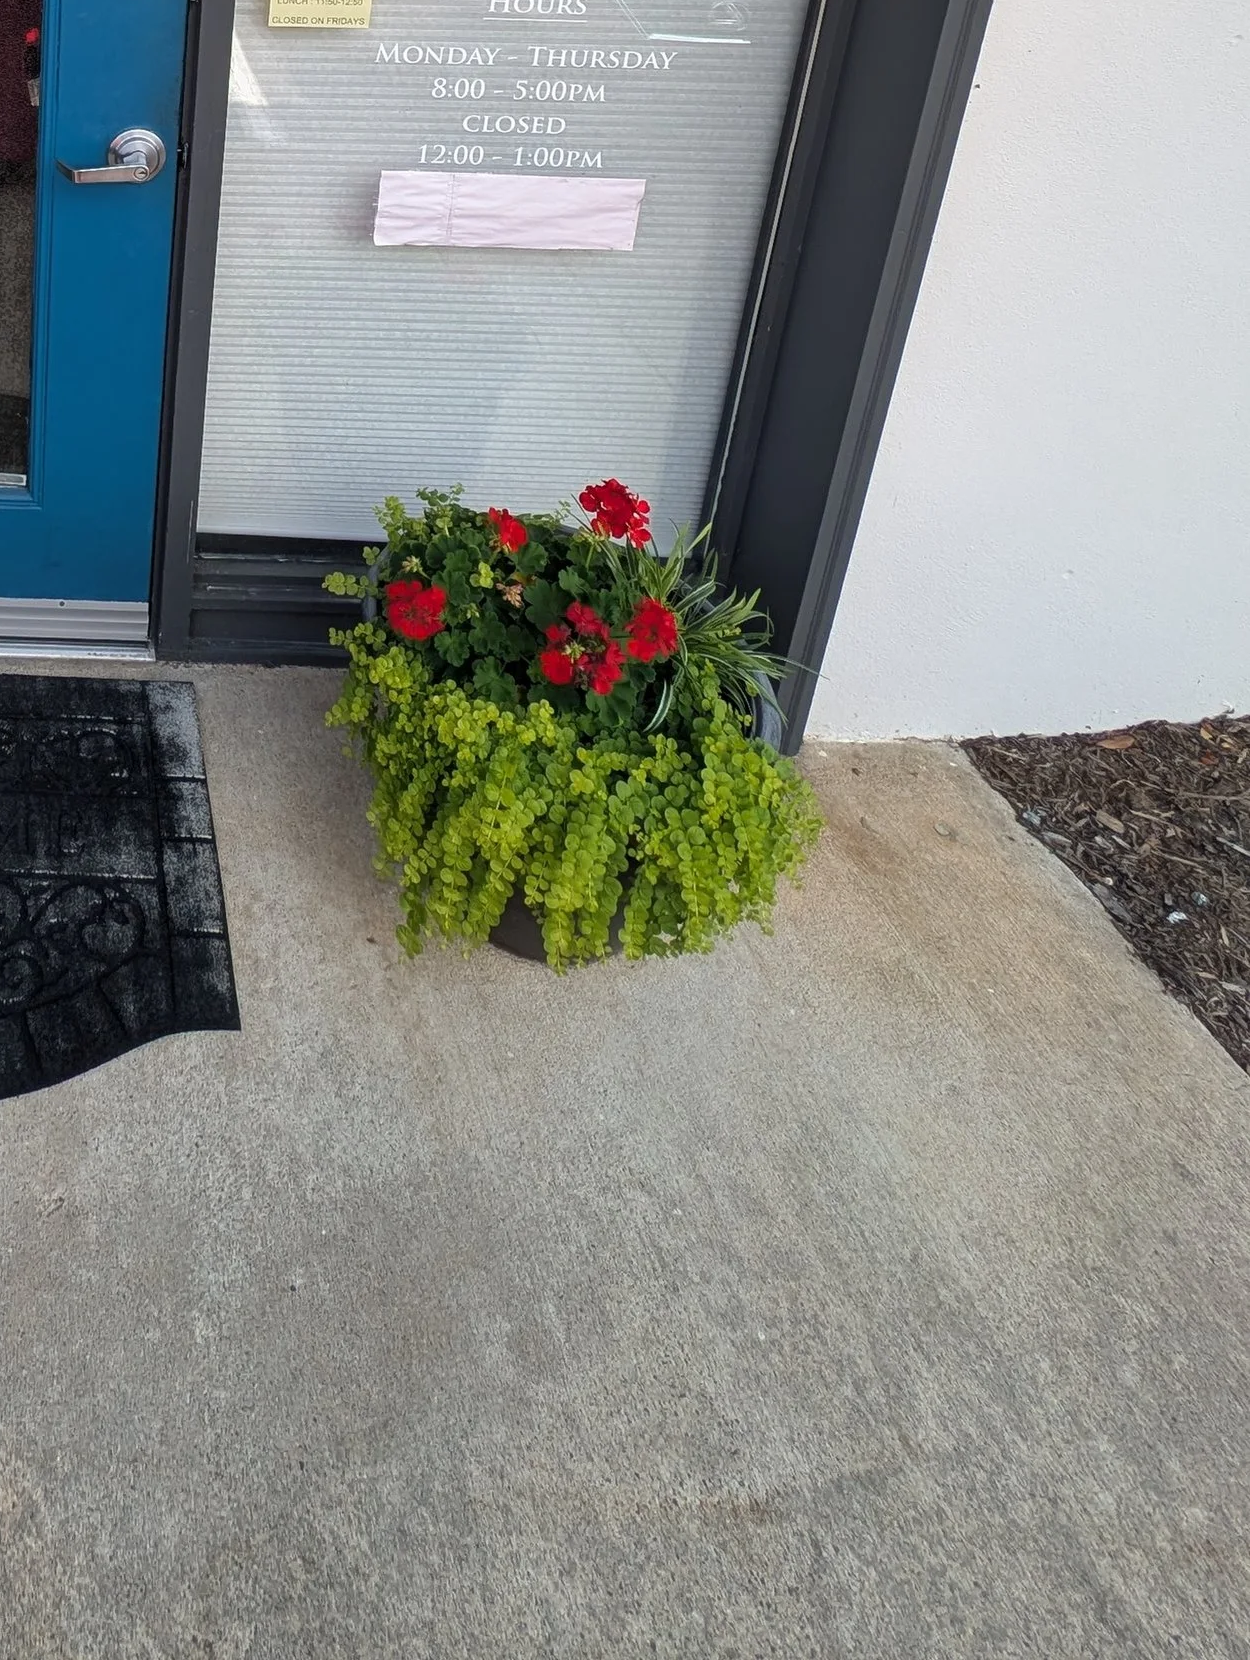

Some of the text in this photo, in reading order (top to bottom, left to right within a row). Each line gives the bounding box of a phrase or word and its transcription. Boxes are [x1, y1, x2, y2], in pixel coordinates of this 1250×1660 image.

[272, 16, 365, 26] CLOSED ON FRIDAYS
[375, 44, 501, 66] MONDAY
[527, 45, 677, 70] THURSDAY
[431, 79, 485, 100] 8:00
[513, 80, 606, 103] 5:00PM
[462, 115, 566, 135] CLOSED
[418, 145, 484, 166] 12:00
[514, 147, 603, 169] 1:00PM
